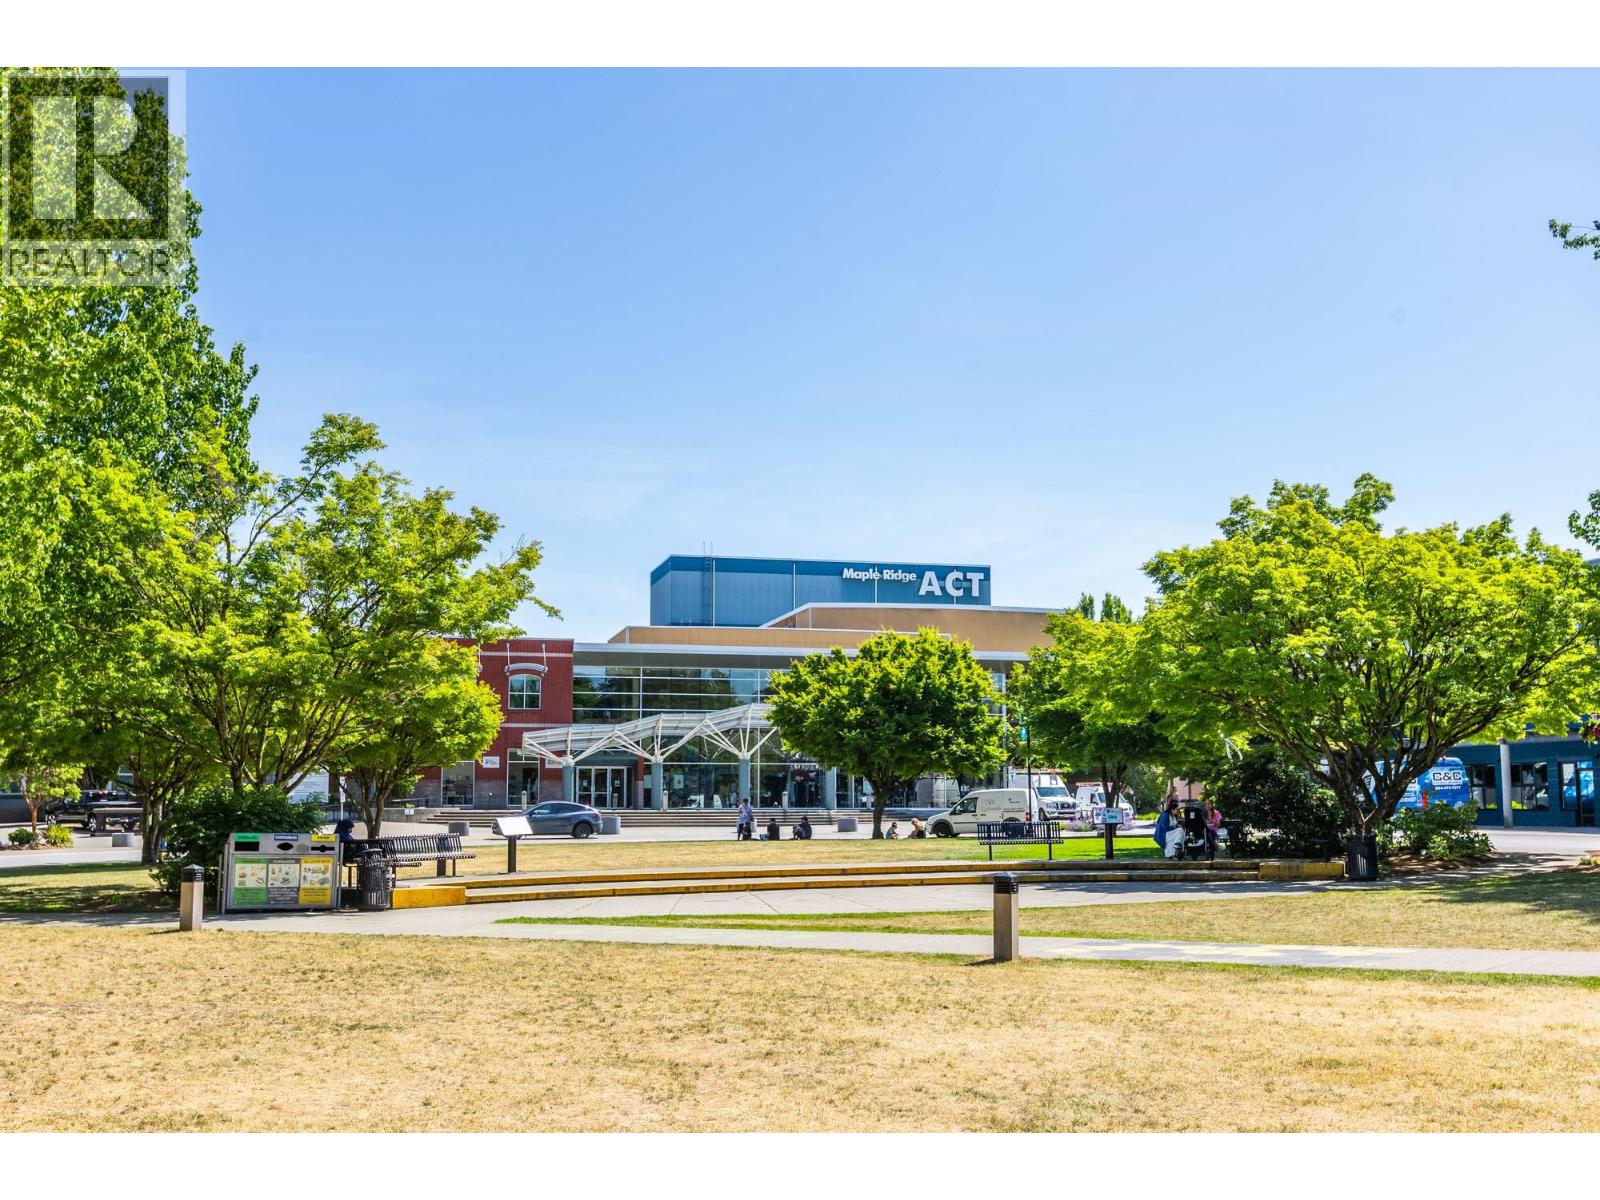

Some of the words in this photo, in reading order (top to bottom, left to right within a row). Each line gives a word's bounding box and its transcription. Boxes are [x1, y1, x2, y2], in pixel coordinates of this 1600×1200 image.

[842, 567, 880, 582] Maple
[883, 569, 917, 583] Ridge
[918, 570, 985, 597] ACT
[1432, 771, 1462, 781] C&C
